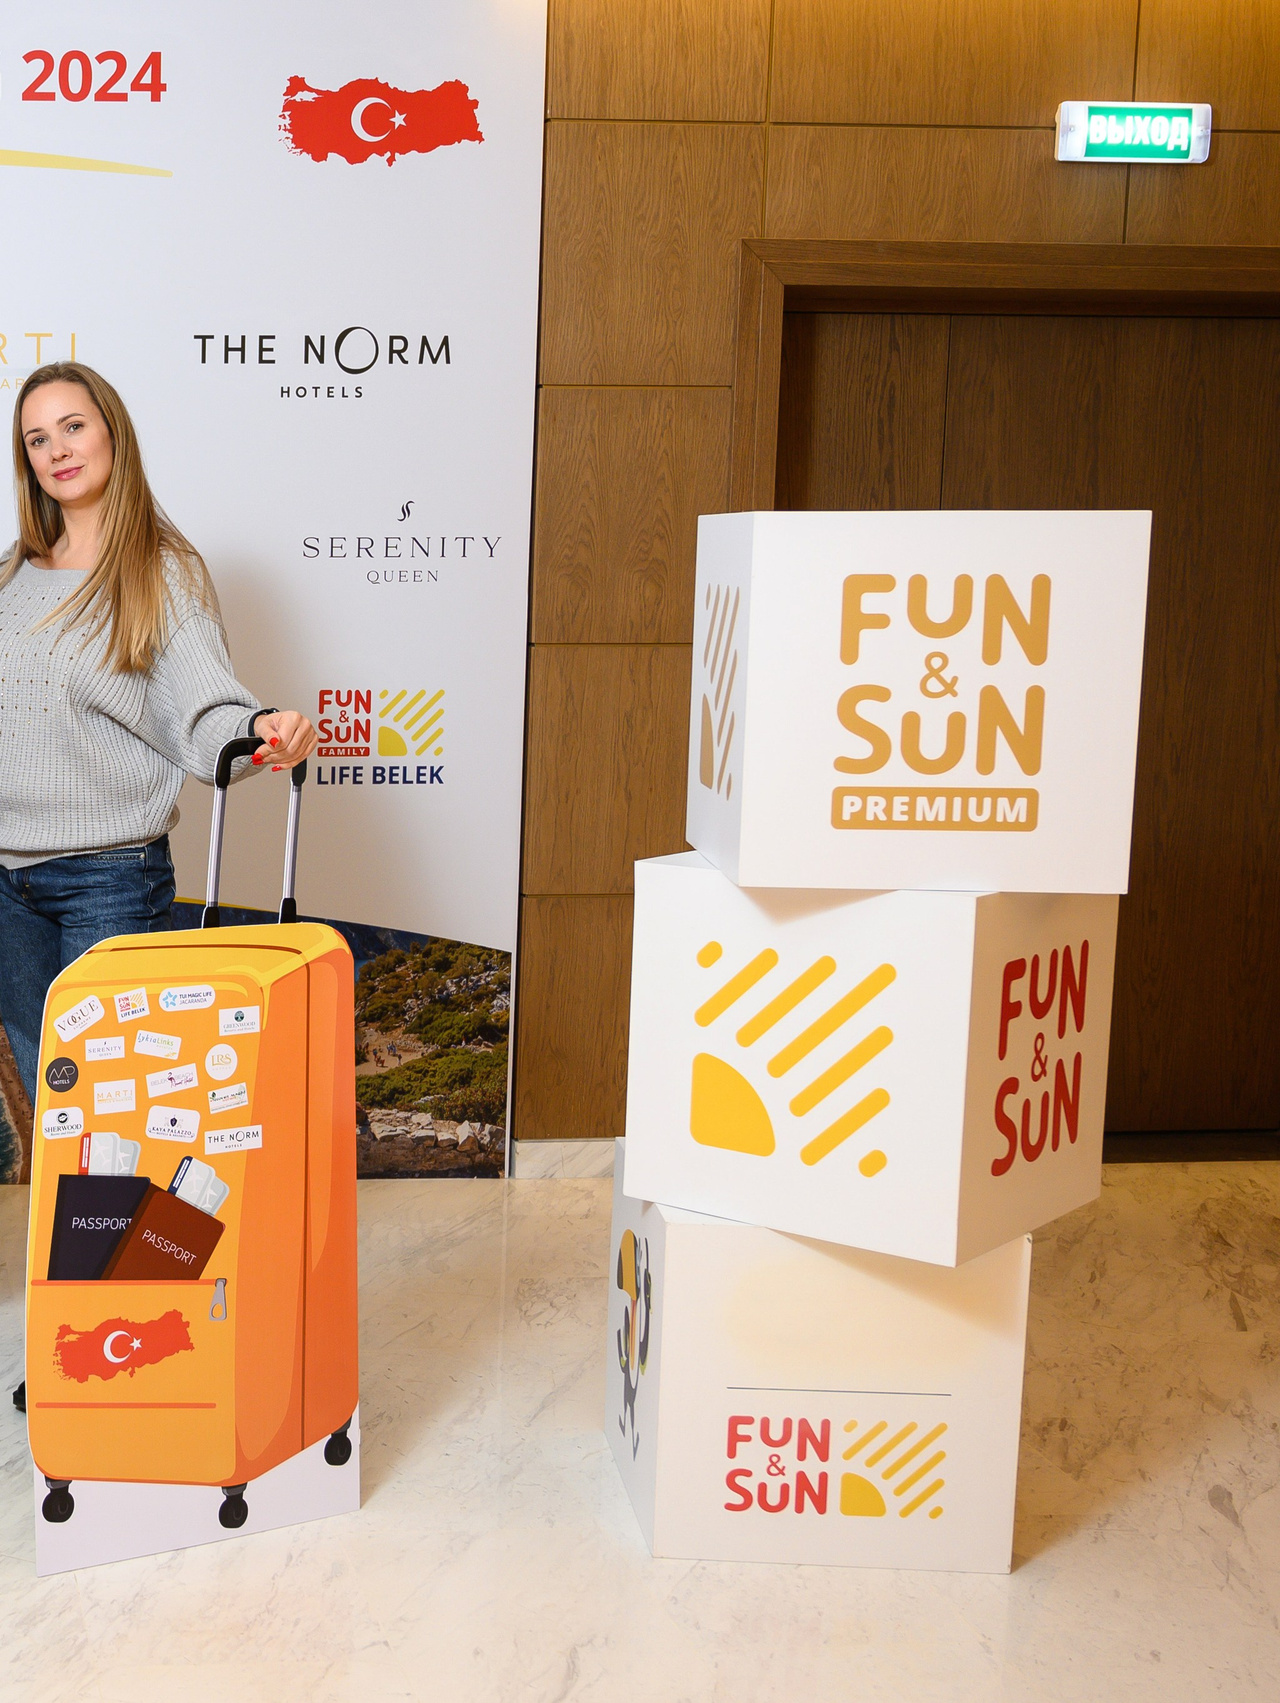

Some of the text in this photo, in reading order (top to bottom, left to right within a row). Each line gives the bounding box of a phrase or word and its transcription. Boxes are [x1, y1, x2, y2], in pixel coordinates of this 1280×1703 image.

[21, 50, 167, 103] 2024
[1089, 115, 1189, 151] ВЫХОД
[194, 326, 452, 375] THE NORM
[280, 386, 364, 398] HOTELS
[302, 536, 502, 558] SERENITY
[366, 570, 439, 584] QUEEN
[839, 573, 1051, 666] FUN
[920, 651, 959, 699] &
[319, 689, 371, 714] FUN
[339, 710, 349, 723] &
[833, 684, 1046, 776] SUN
[318, 718, 371, 744] SUN
[322, 748, 366, 756] FAMILY
[317, 765, 444, 785] LIFE BELEK
[842, 795, 1028, 823] PREMIUM
[998, 939, 1089, 1061] FUN
[1030, 1031, 1048, 1082] &
[44, 1123, 82, 1133] SHERWOOD
[208, 1131, 259, 1144] THE NORM
[141, 1229, 197, 1266] PASSPORT
[726, 1415, 831, 1462] FUN
[766, 1453, 786, 1477] &
[724, 1468, 829, 1516] SUN
